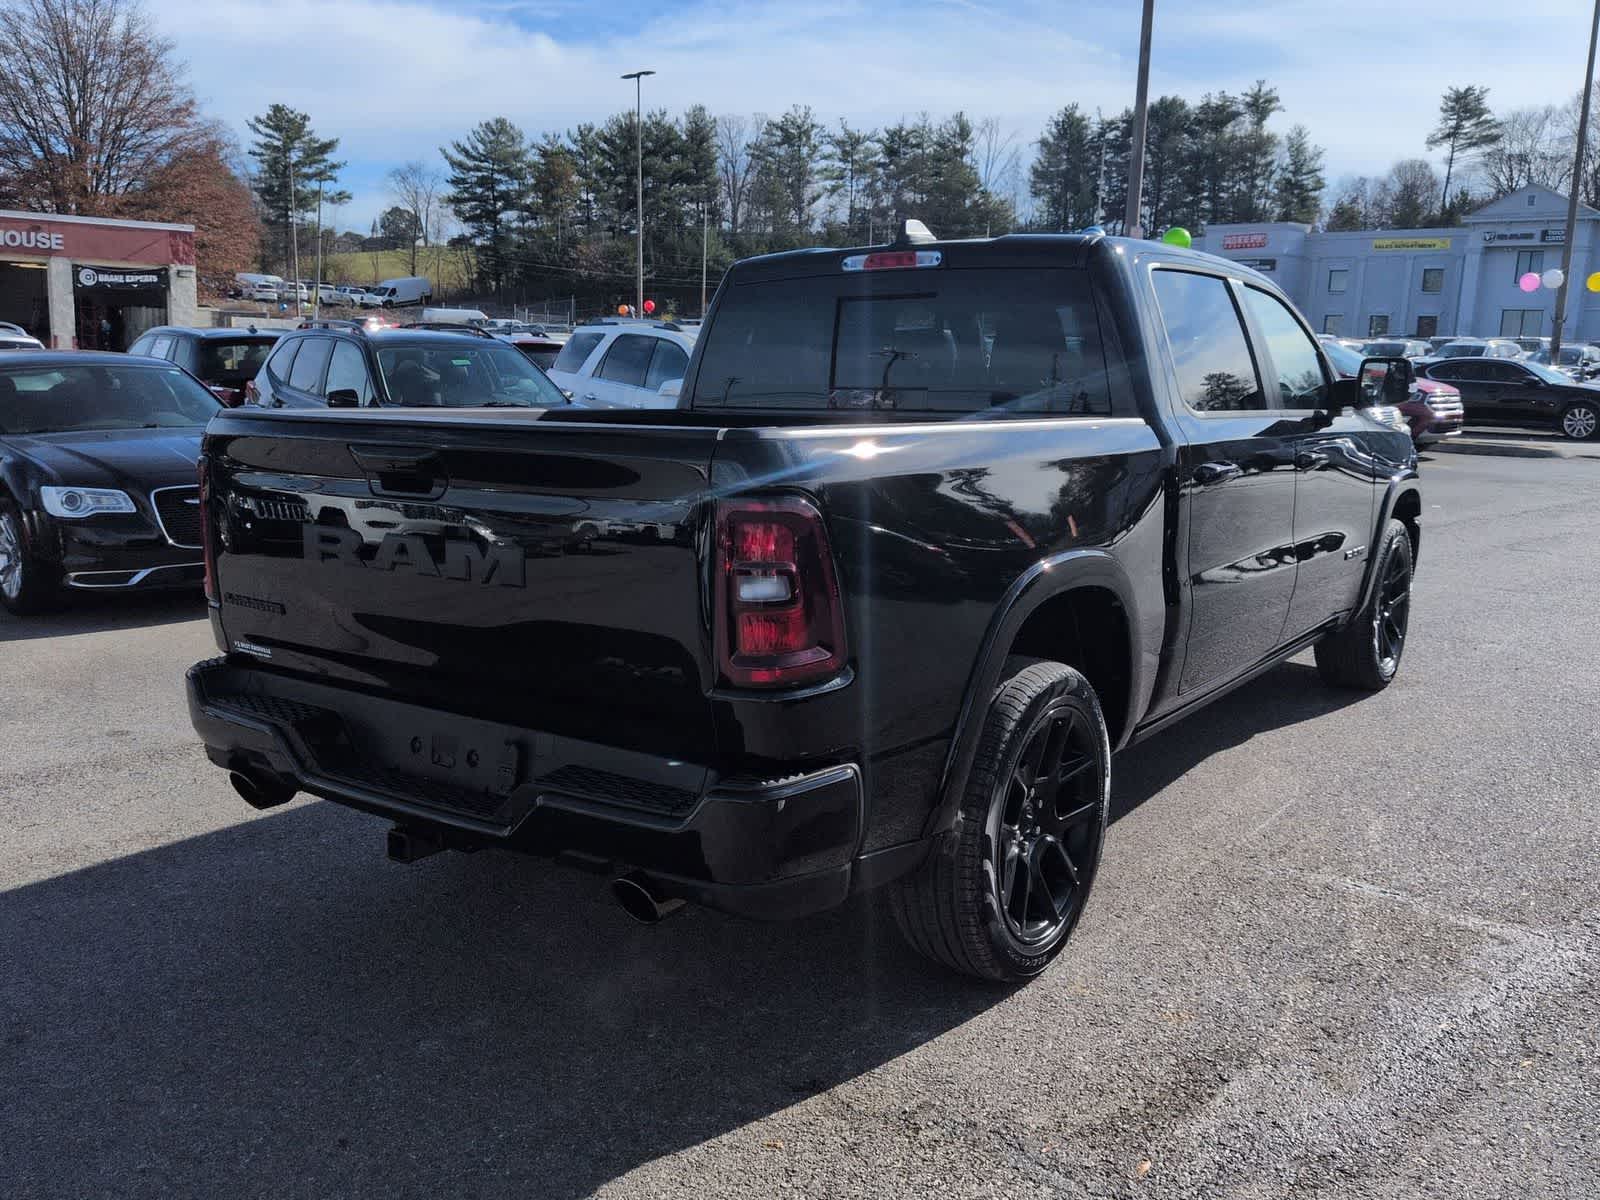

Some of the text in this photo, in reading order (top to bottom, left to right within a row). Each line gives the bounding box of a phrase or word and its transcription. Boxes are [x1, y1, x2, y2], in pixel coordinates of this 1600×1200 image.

[98, 273, 158, 283] BRAKE EXPERTS
[303, 523, 526, 588] RAM
